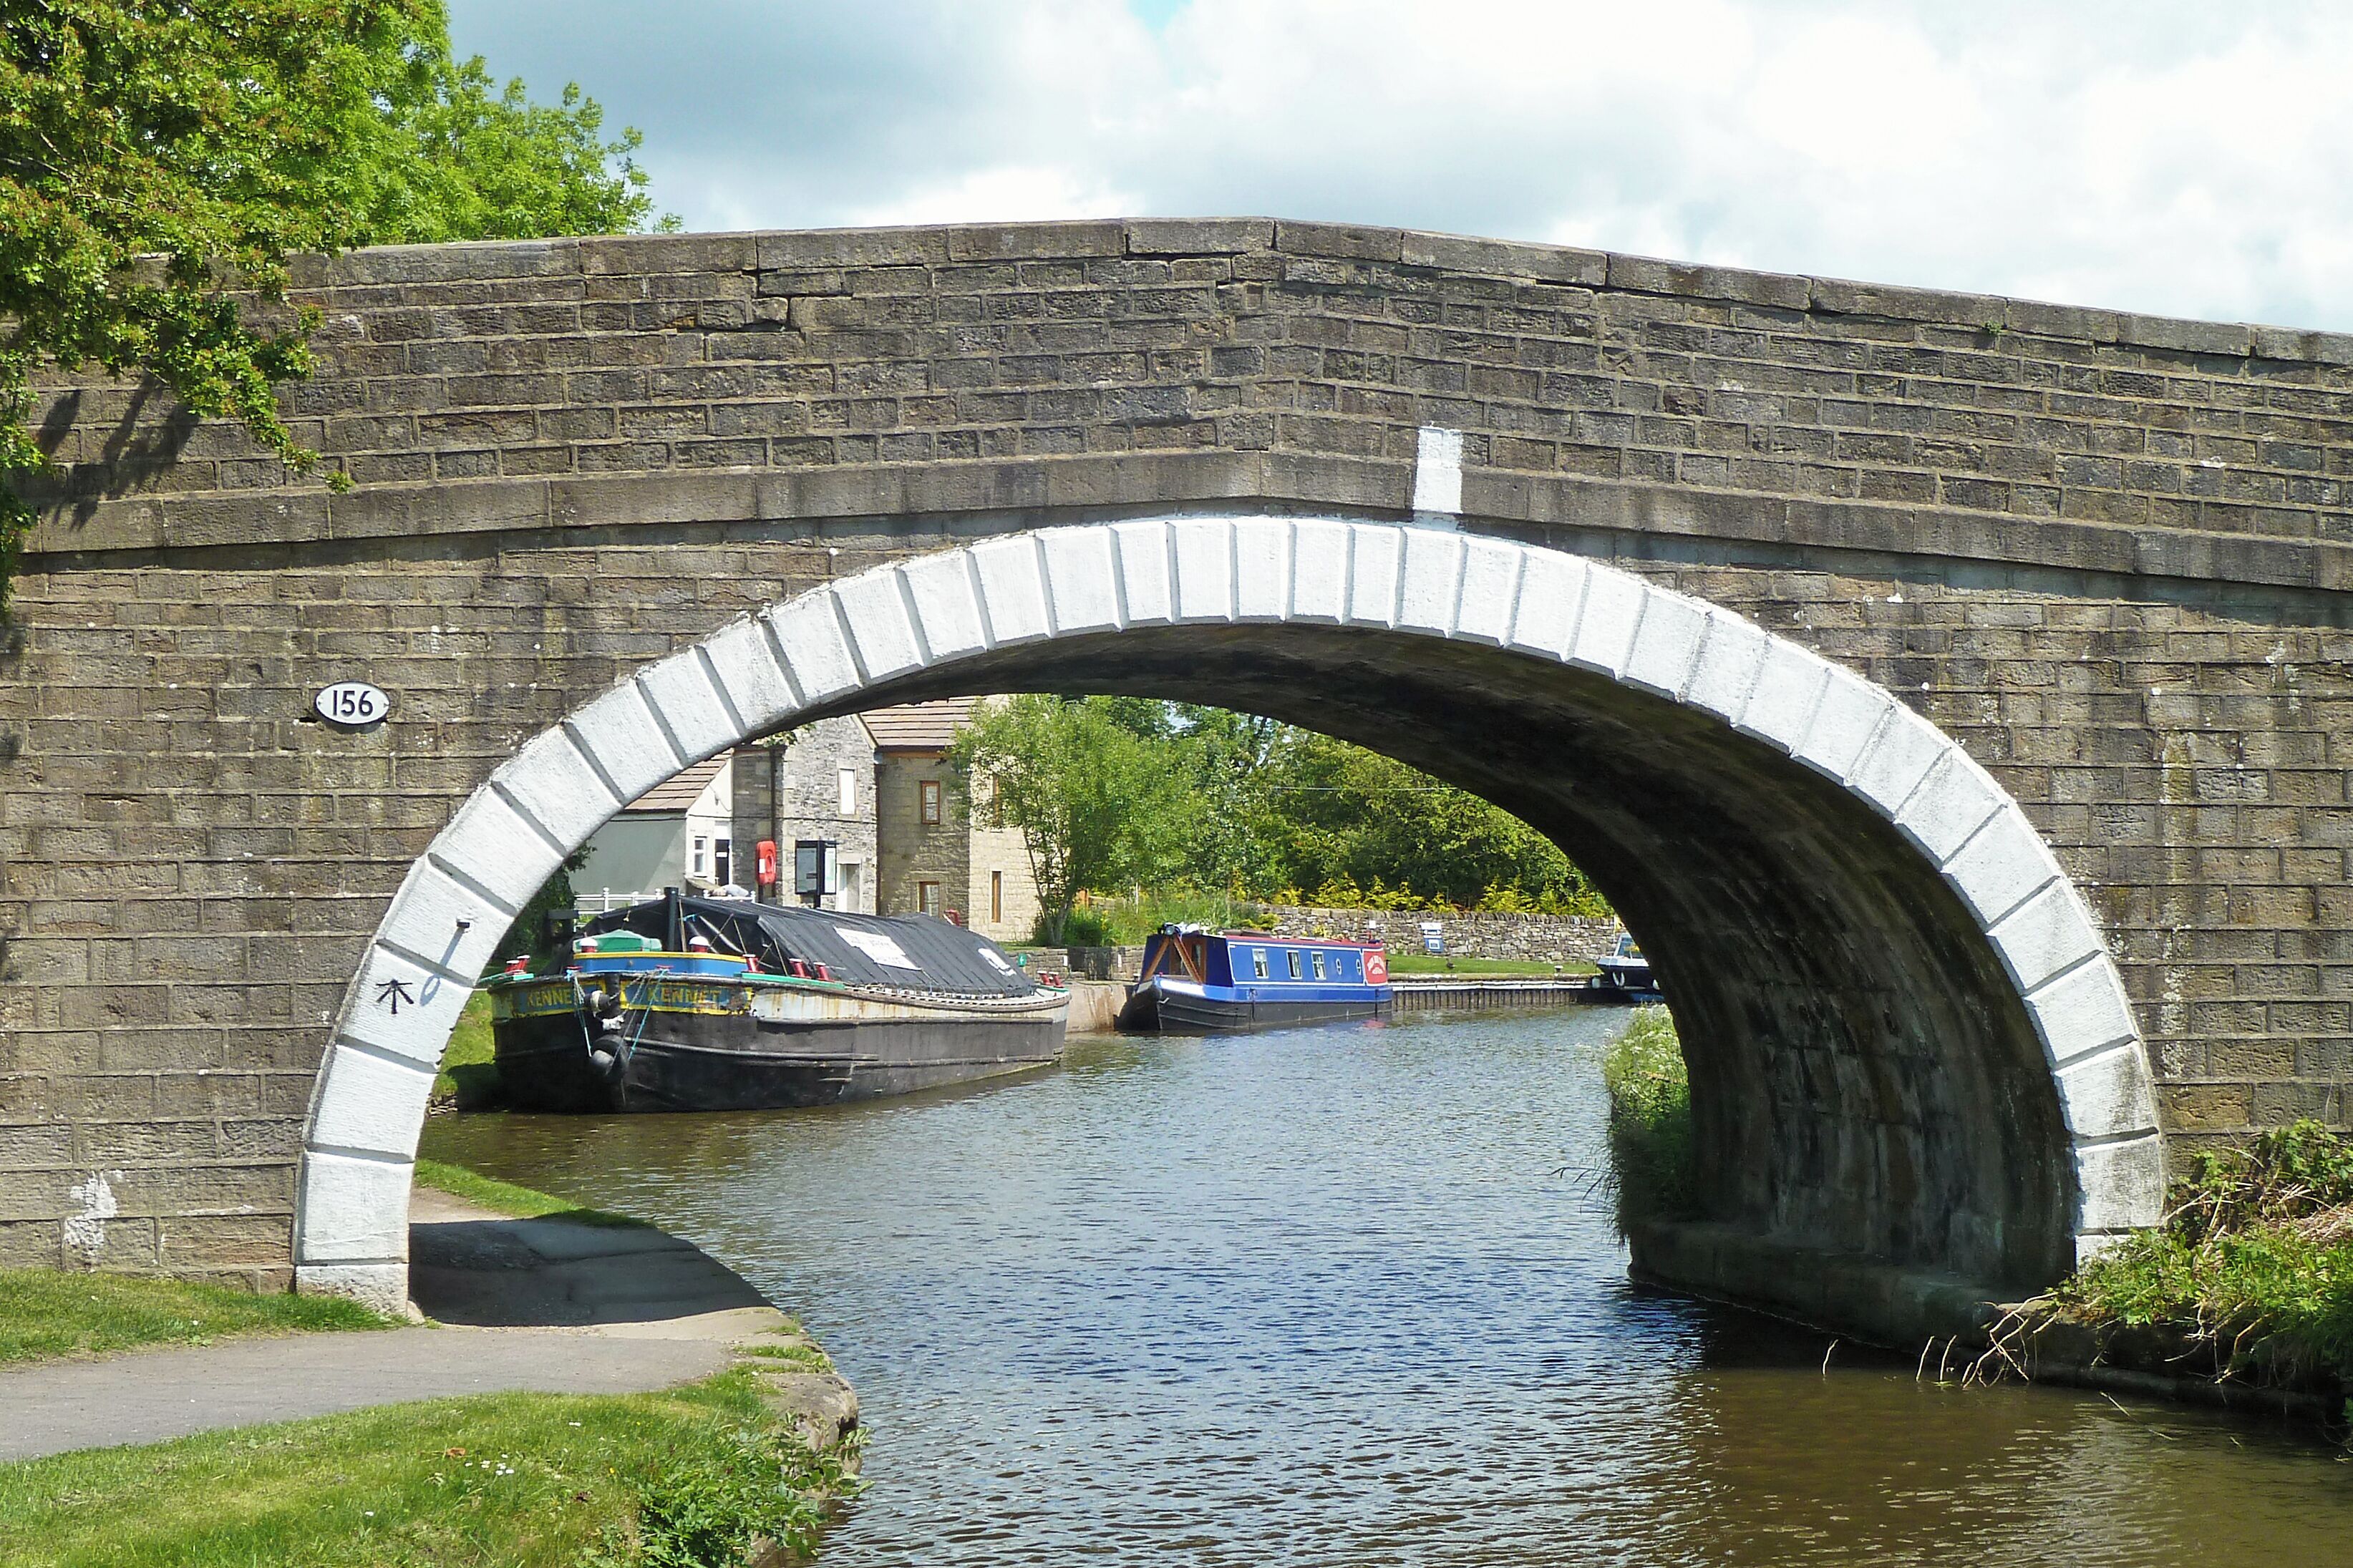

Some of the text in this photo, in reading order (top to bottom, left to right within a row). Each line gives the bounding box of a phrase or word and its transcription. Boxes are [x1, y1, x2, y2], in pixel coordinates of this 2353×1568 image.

[333, 690, 374, 717] 156
[527, 988, 577, 1008] KENNE
[647, 986, 722, 1003] KENNET
